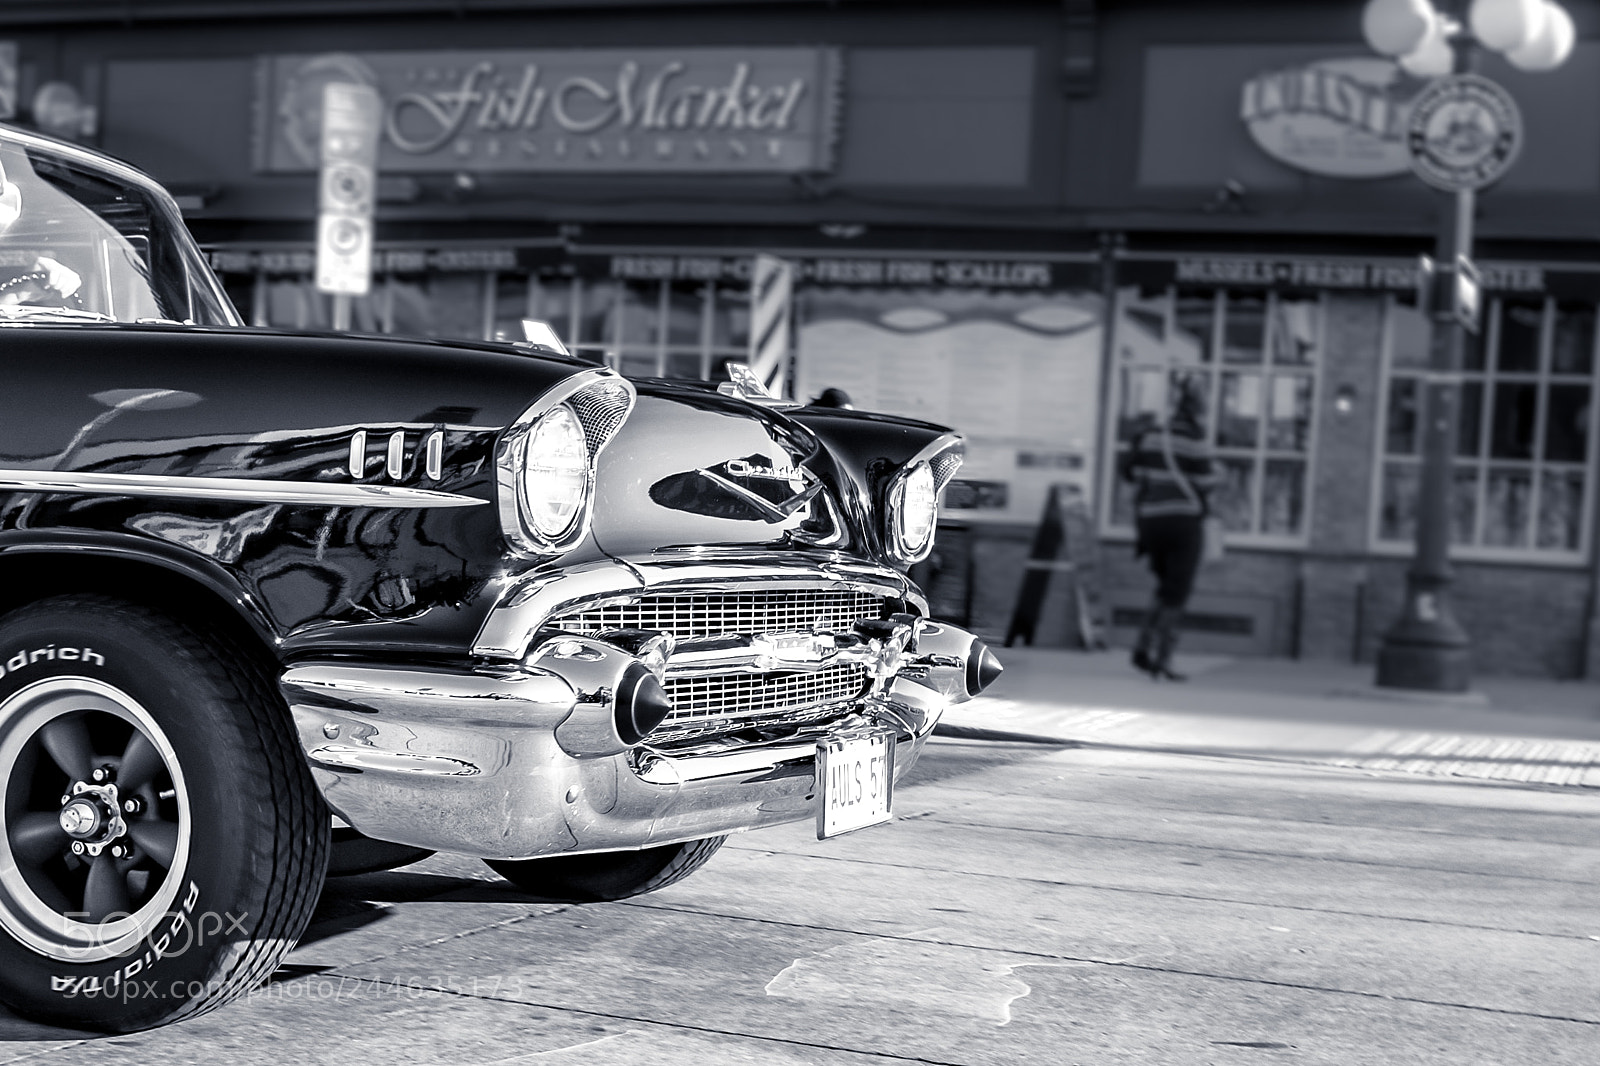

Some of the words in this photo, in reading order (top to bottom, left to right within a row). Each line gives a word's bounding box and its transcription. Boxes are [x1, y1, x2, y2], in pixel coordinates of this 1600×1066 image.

[387, 61, 547, 154] Fish
[552, 61, 804, 132] Market
[610, 257, 676, 280] FRESH
[679, 258, 721, 280] FISH
[816, 260, 882, 283] FRESH
[886, 261, 933, 284] FISH
[947, 262, 1051, 286] SCALLOPS
[1176, 260, 1276, 283] MUSSELS
[1290, 263, 1367, 286] FRESH
[826, 760, 863, 810] AULS
[112, 880, 200, 987] Radial
